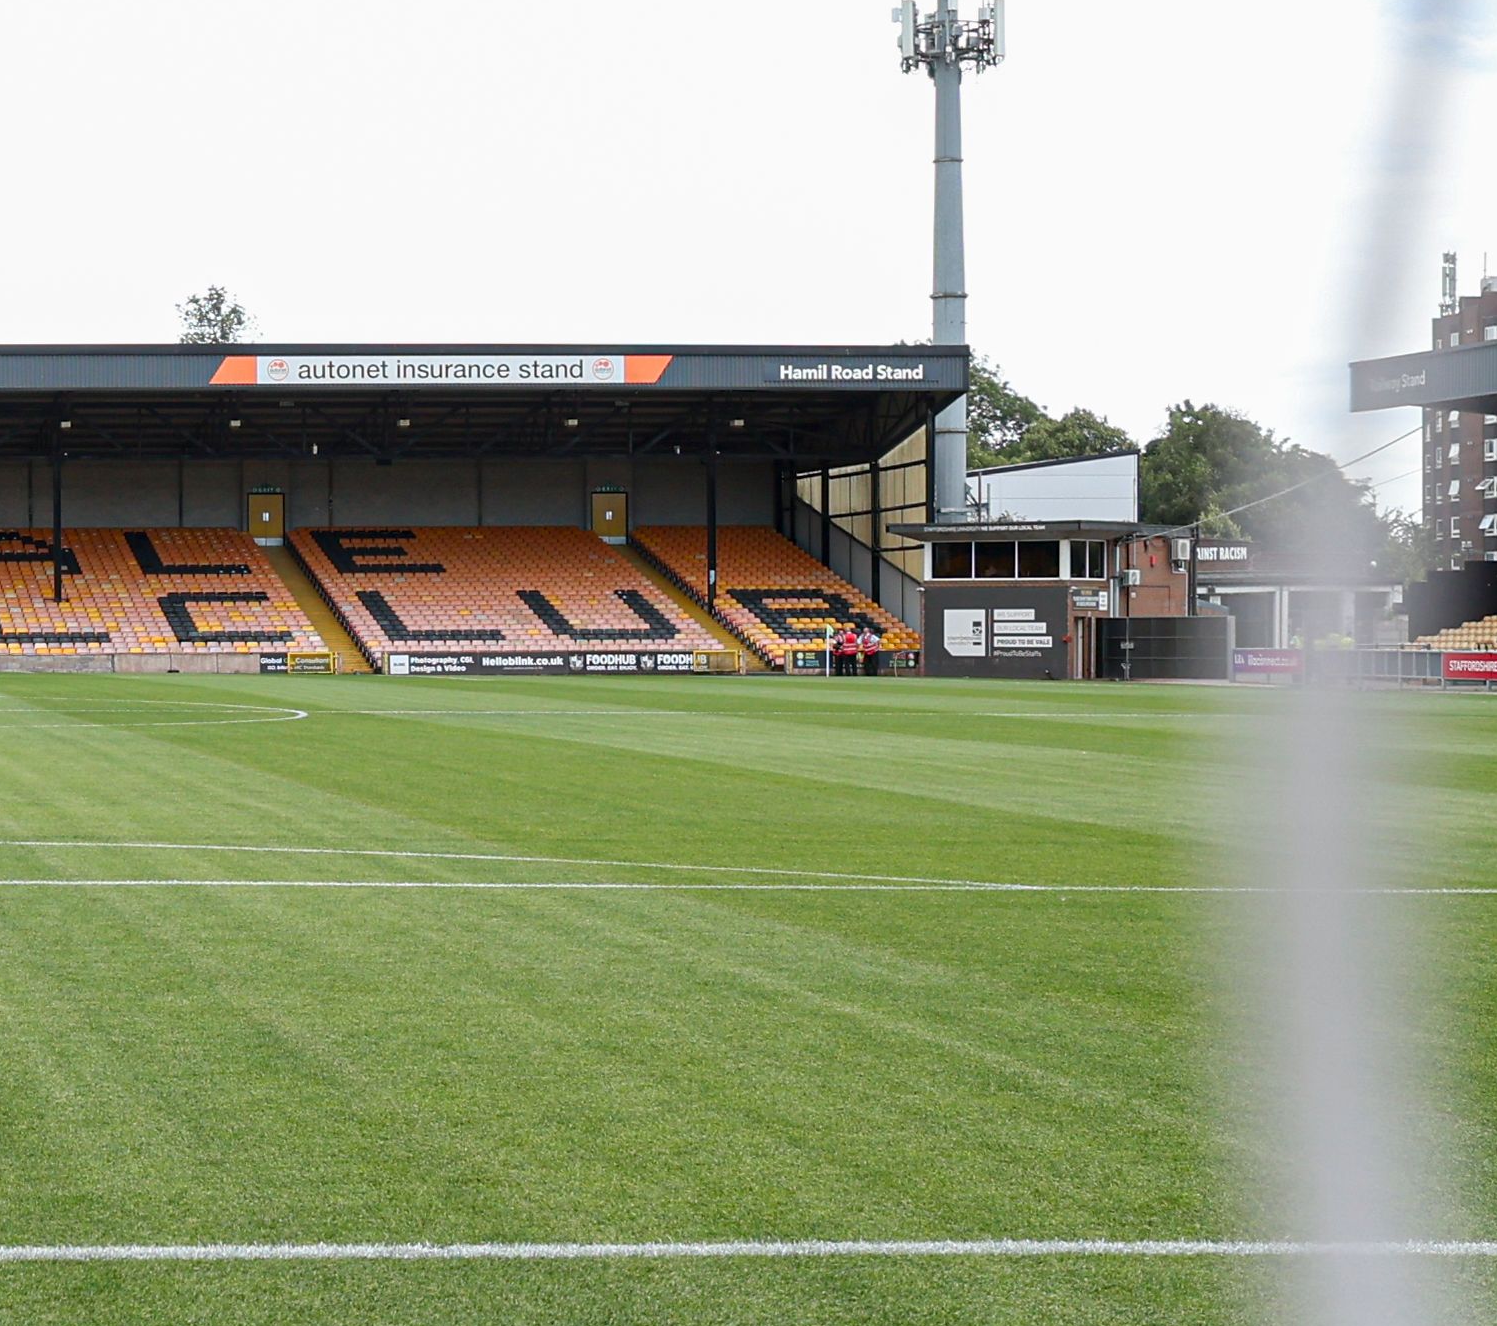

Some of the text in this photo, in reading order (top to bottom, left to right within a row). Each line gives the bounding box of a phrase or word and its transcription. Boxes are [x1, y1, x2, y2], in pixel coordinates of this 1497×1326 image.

[298, 359, 584, 380] autonet insurance stand
[779, 364, 924, 380] Hamil Road Stand
[1219, 547, 1247, 560] RACISM
[410, 656, 458, 666] Photography,
[482, 656, 564, 667] Helloblink.co.uk
[586, 654, 637, 665] FOODHUB
[410, 665, 435, 673] Design
